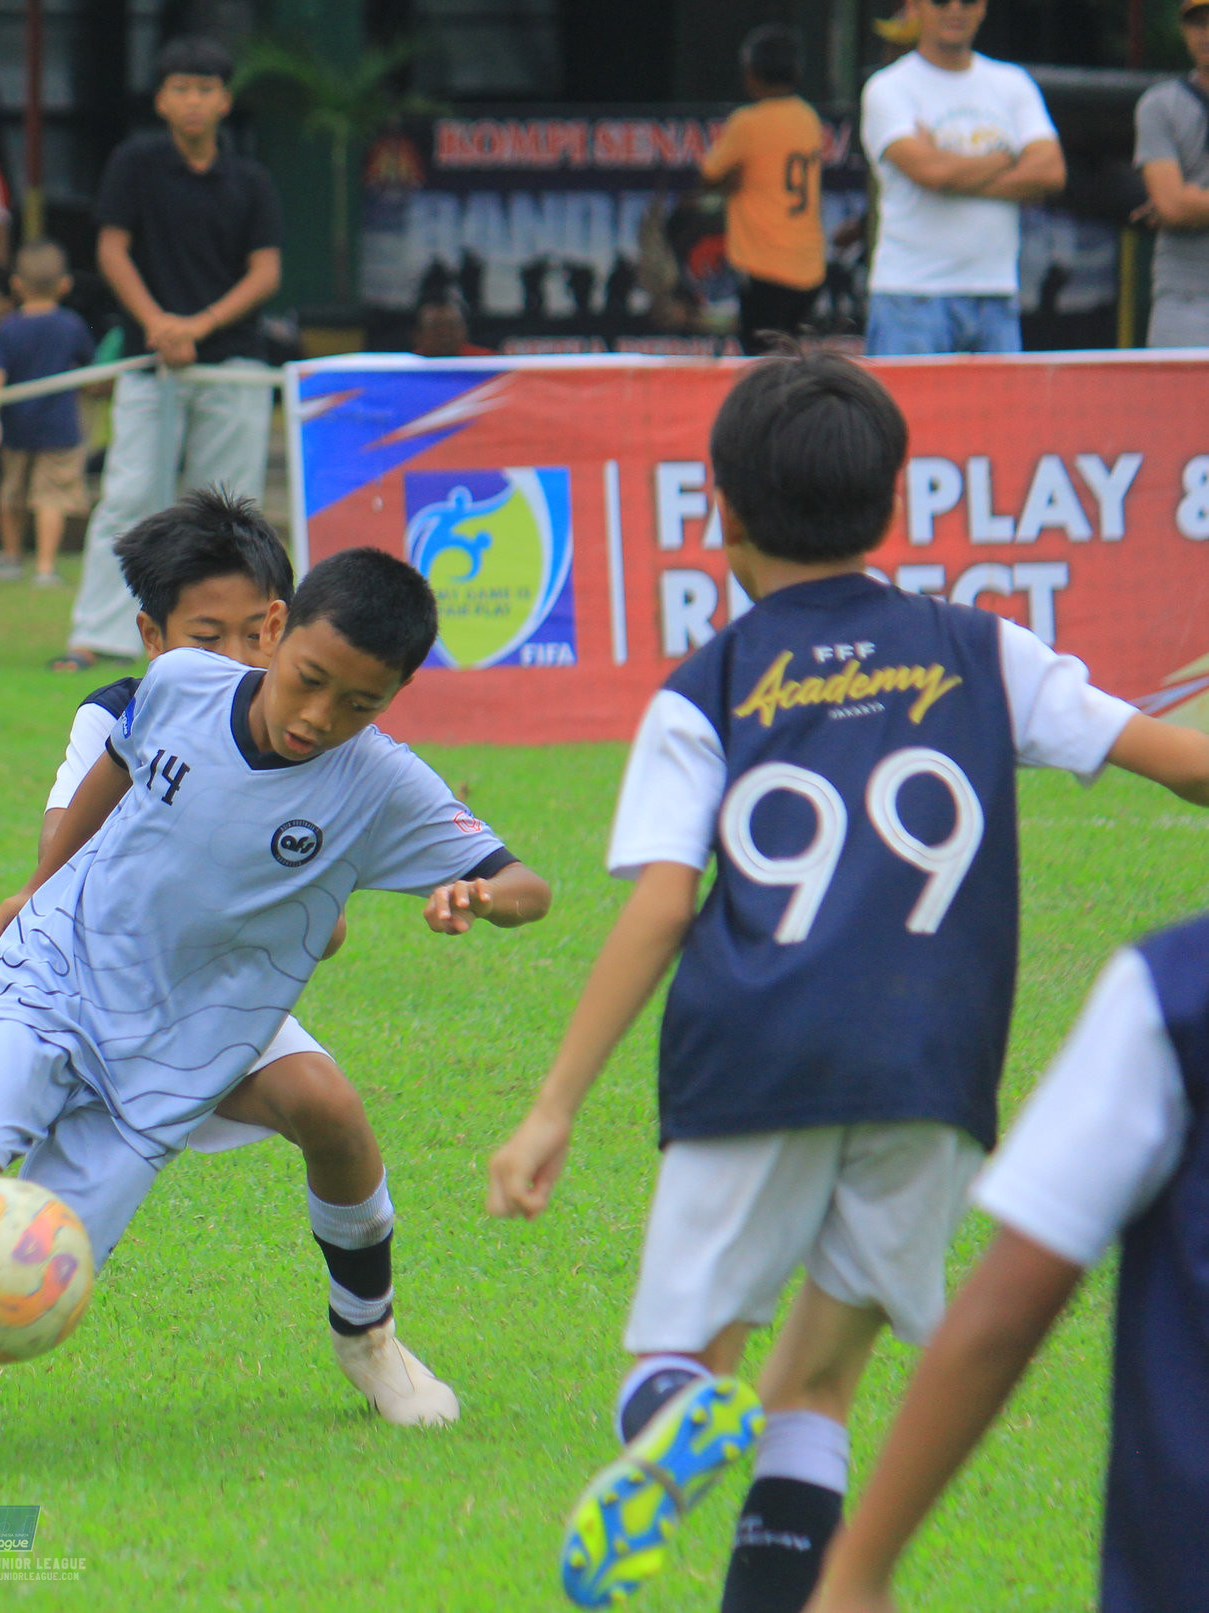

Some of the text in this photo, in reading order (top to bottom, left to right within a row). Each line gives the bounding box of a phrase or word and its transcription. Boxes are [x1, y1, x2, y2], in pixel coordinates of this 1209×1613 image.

[907, 452, 1144, 545] PLAY
[521, 641, 577, 668] FIFA
[812, 640, 877, 664] FFF
[733, 649, 964, 728] Academy
[146, 749, 191, 807] 14
[718, 746, 986, 946] 99
